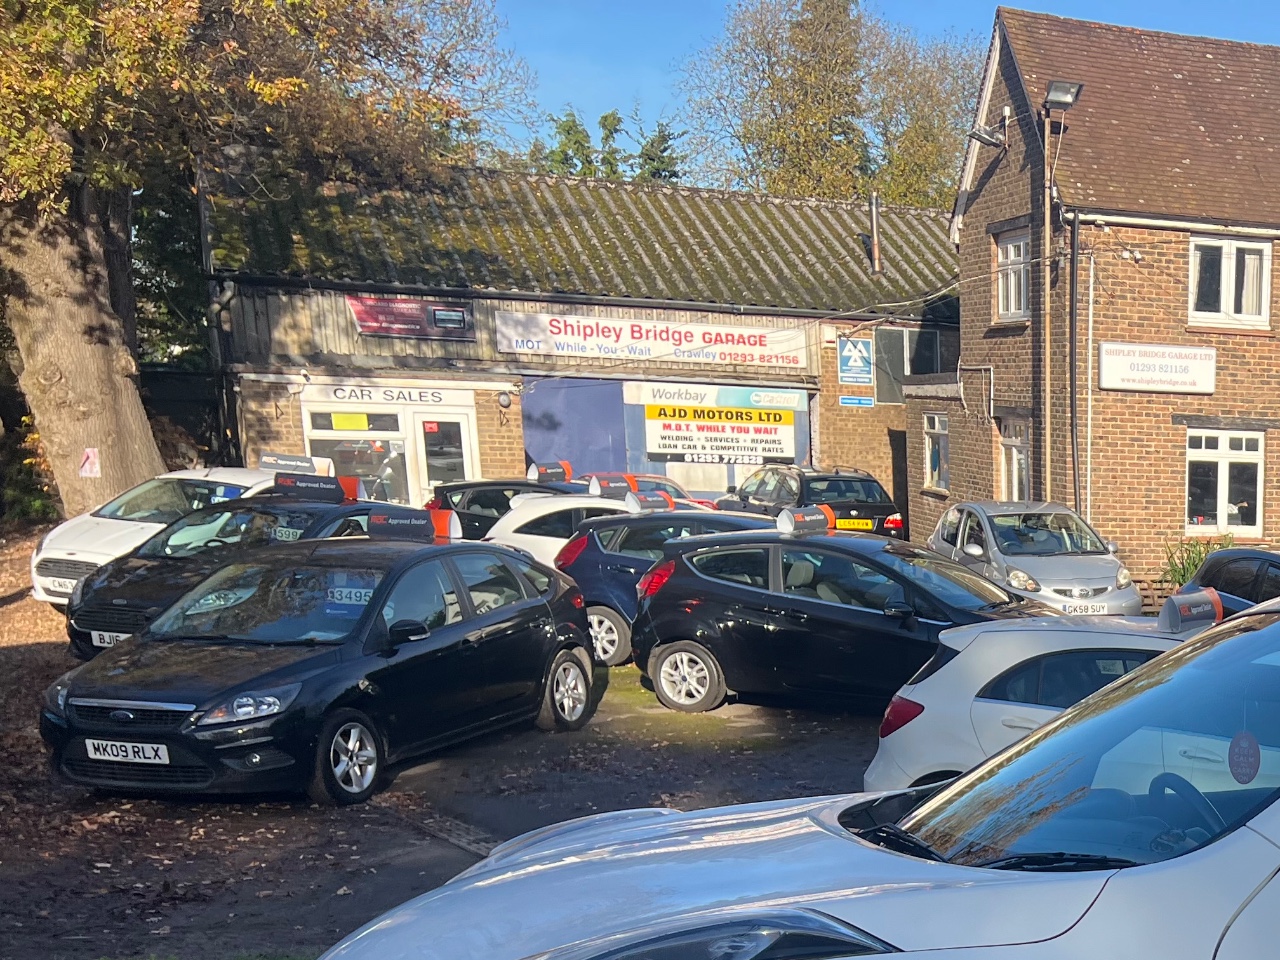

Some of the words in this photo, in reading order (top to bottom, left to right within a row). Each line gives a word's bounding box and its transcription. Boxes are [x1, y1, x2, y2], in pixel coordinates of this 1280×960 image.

[549, 318, 623, 343] Shipley
[630, 323, 694, 347] Bridge
[702, 331, 767, 347] GARAGE
[515, 339, 541, 350] MOT
[555, 341, 587, 353] While
[626, 345, 652, 357] Wait
[674, 348, 717, 361] Crawley
[719, 351, 755, 362] 01293
[759, 354, 799, 365] 821156
[1104, 348, 1137, 357] SHIPLEY
[1138, 350, 1167, 358] BRIDGE
[1168, 351, 1198, 360] GARAGE
[1199, 353, 1214, 361] LTD
[1129, 362, 1156, 372] 01293
[1158, 364, 1190, 374] 821156
[1120, 376, 1197, 387] www.shipleybridge.co.uk
[333, 387, 372, 400] CAR
[383, 389, 443, 403] SALES
[651, 387, 707, 404] Workbay
[762, 393, 797, 405] Castrol
[657, 407, 688, 419] AJD
[693, 409, 753, 422] MOTORS
[758, 411, 783, 423] LTD
[662, 423, 693, 432] M.O.T.
[696, 424, 727, 433] WHILE
[730, 426, 750, 434] YOU
[753, 427, 779, 435] WAIT
[704, 436, 740, 444] SERVICES
[710, 445, 759, 453] COMPETITIVE
[761, 446, 784, 454] RATES
[295, 480, 320, 488] Approved
[1067, 604, 1089, 614] GK58
[1090, 604, 1106, 613] SUY
[91, 741, 129, 758] MK09
[131, 745, 162, 760] RLX
